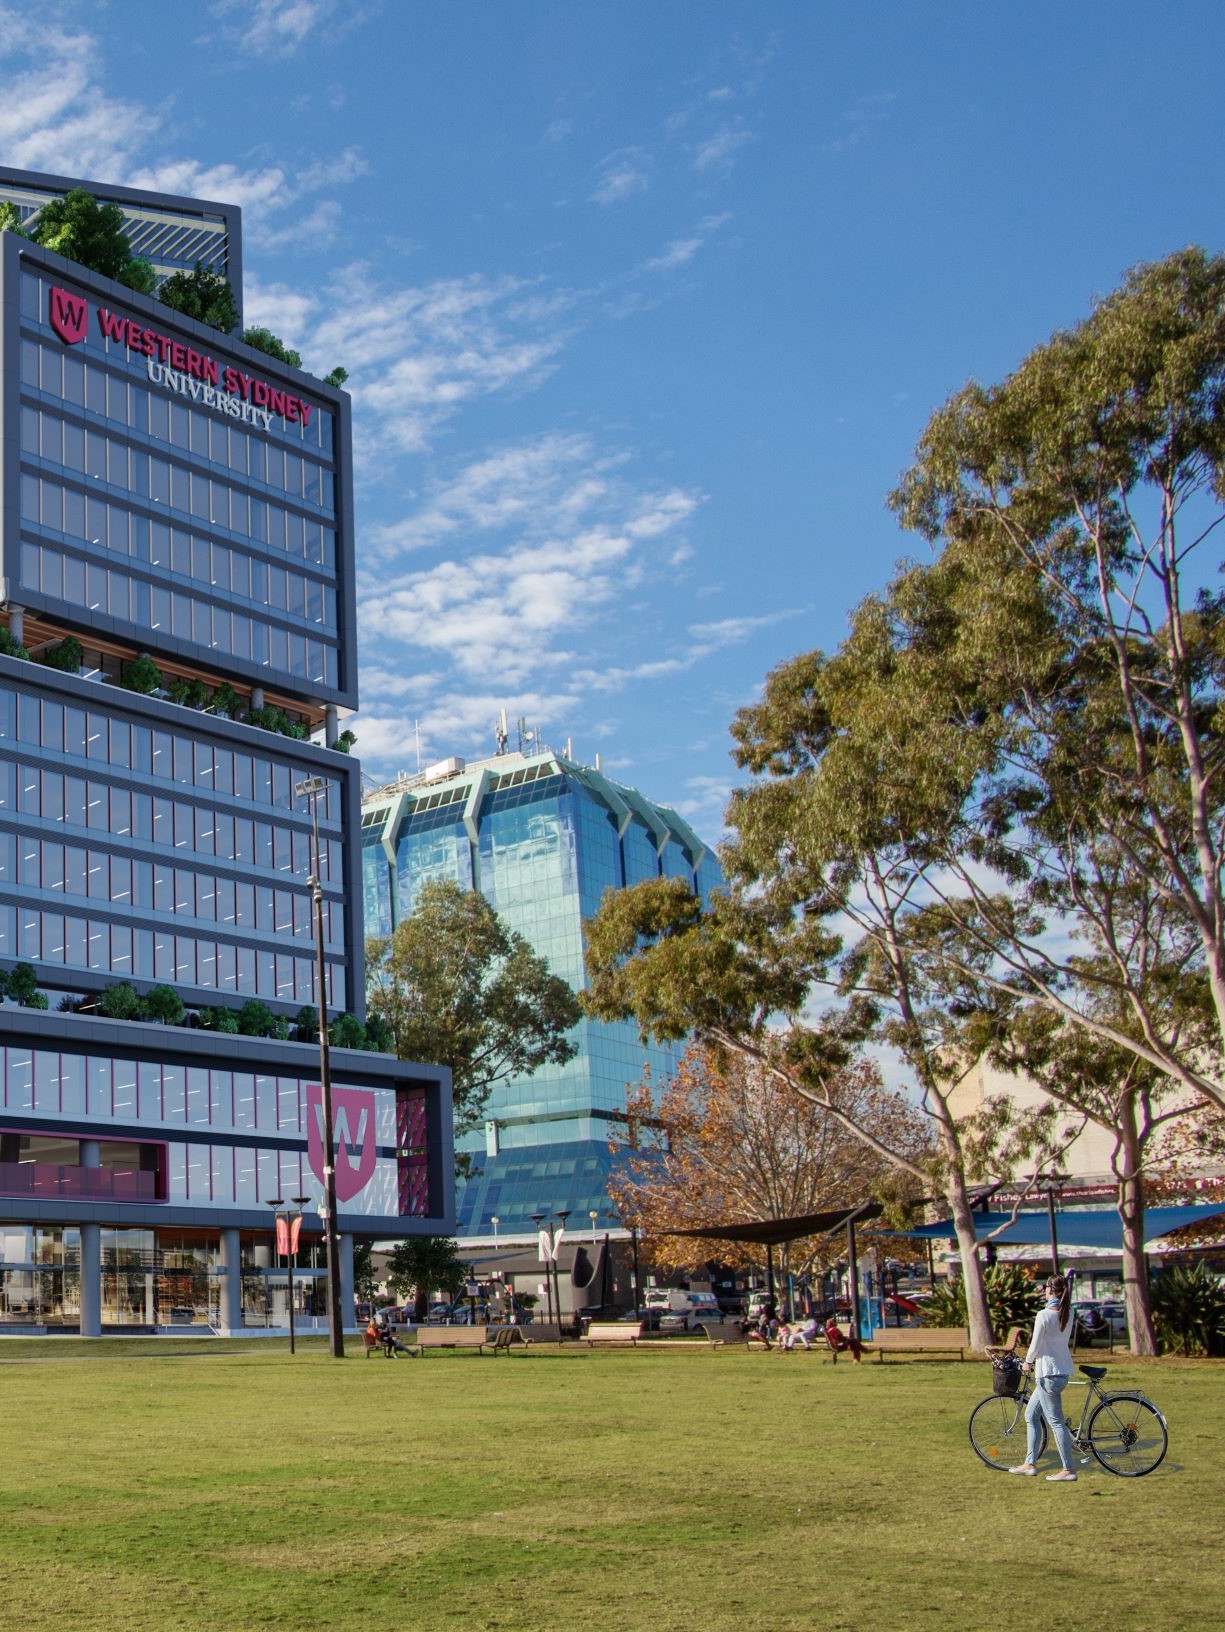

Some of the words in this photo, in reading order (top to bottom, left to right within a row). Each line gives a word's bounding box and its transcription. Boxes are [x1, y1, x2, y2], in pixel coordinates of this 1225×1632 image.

[56, 295, 84, 332] W
[97, 307, 218, 386] WESTERN
[223, 366, 312, 427] SYDNEY
[146, 359, 274, 433] UNIVERSITY
[313, 1103, 369, 1172] W
